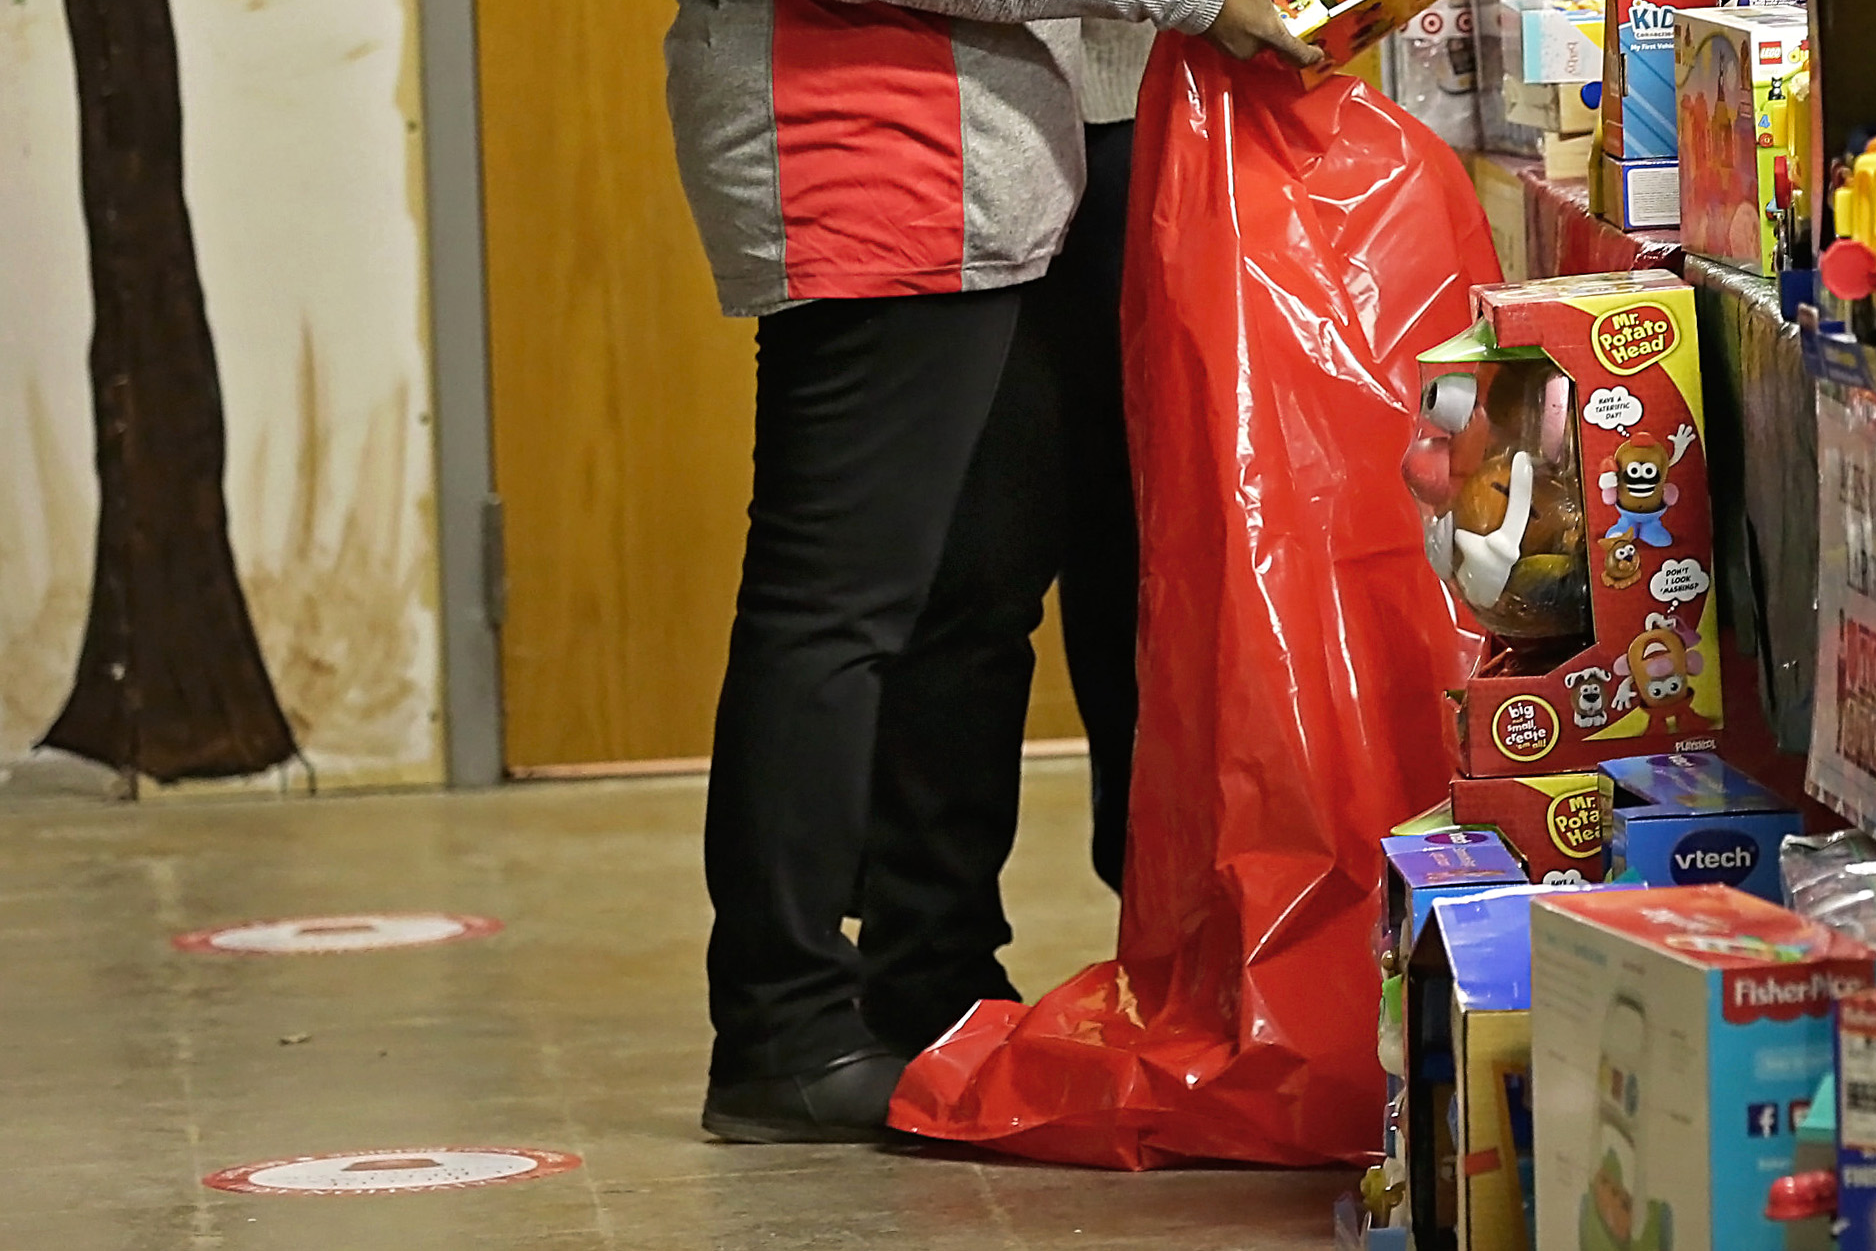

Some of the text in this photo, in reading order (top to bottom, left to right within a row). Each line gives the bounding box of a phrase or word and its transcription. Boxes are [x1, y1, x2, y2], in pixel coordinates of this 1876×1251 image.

[1611, 312, 1639, 330] Mr.
[1600, 320, 1668, 351] Potato
[1611, 333, 1665, 364] Head
[1665, 567, 1689, 577] DON'T
[1671, 575, 1691, 584] LOOK
[1508, 702, 1534, 719] big
[1507, 719, 1537, 732] small,
[1505, 728, 1546, 745] create
[1569, 795, 1597, 813] Mr.
[1555, 809, 1600, 832] Pota
[1675, 846, 1751, 870] vtech
